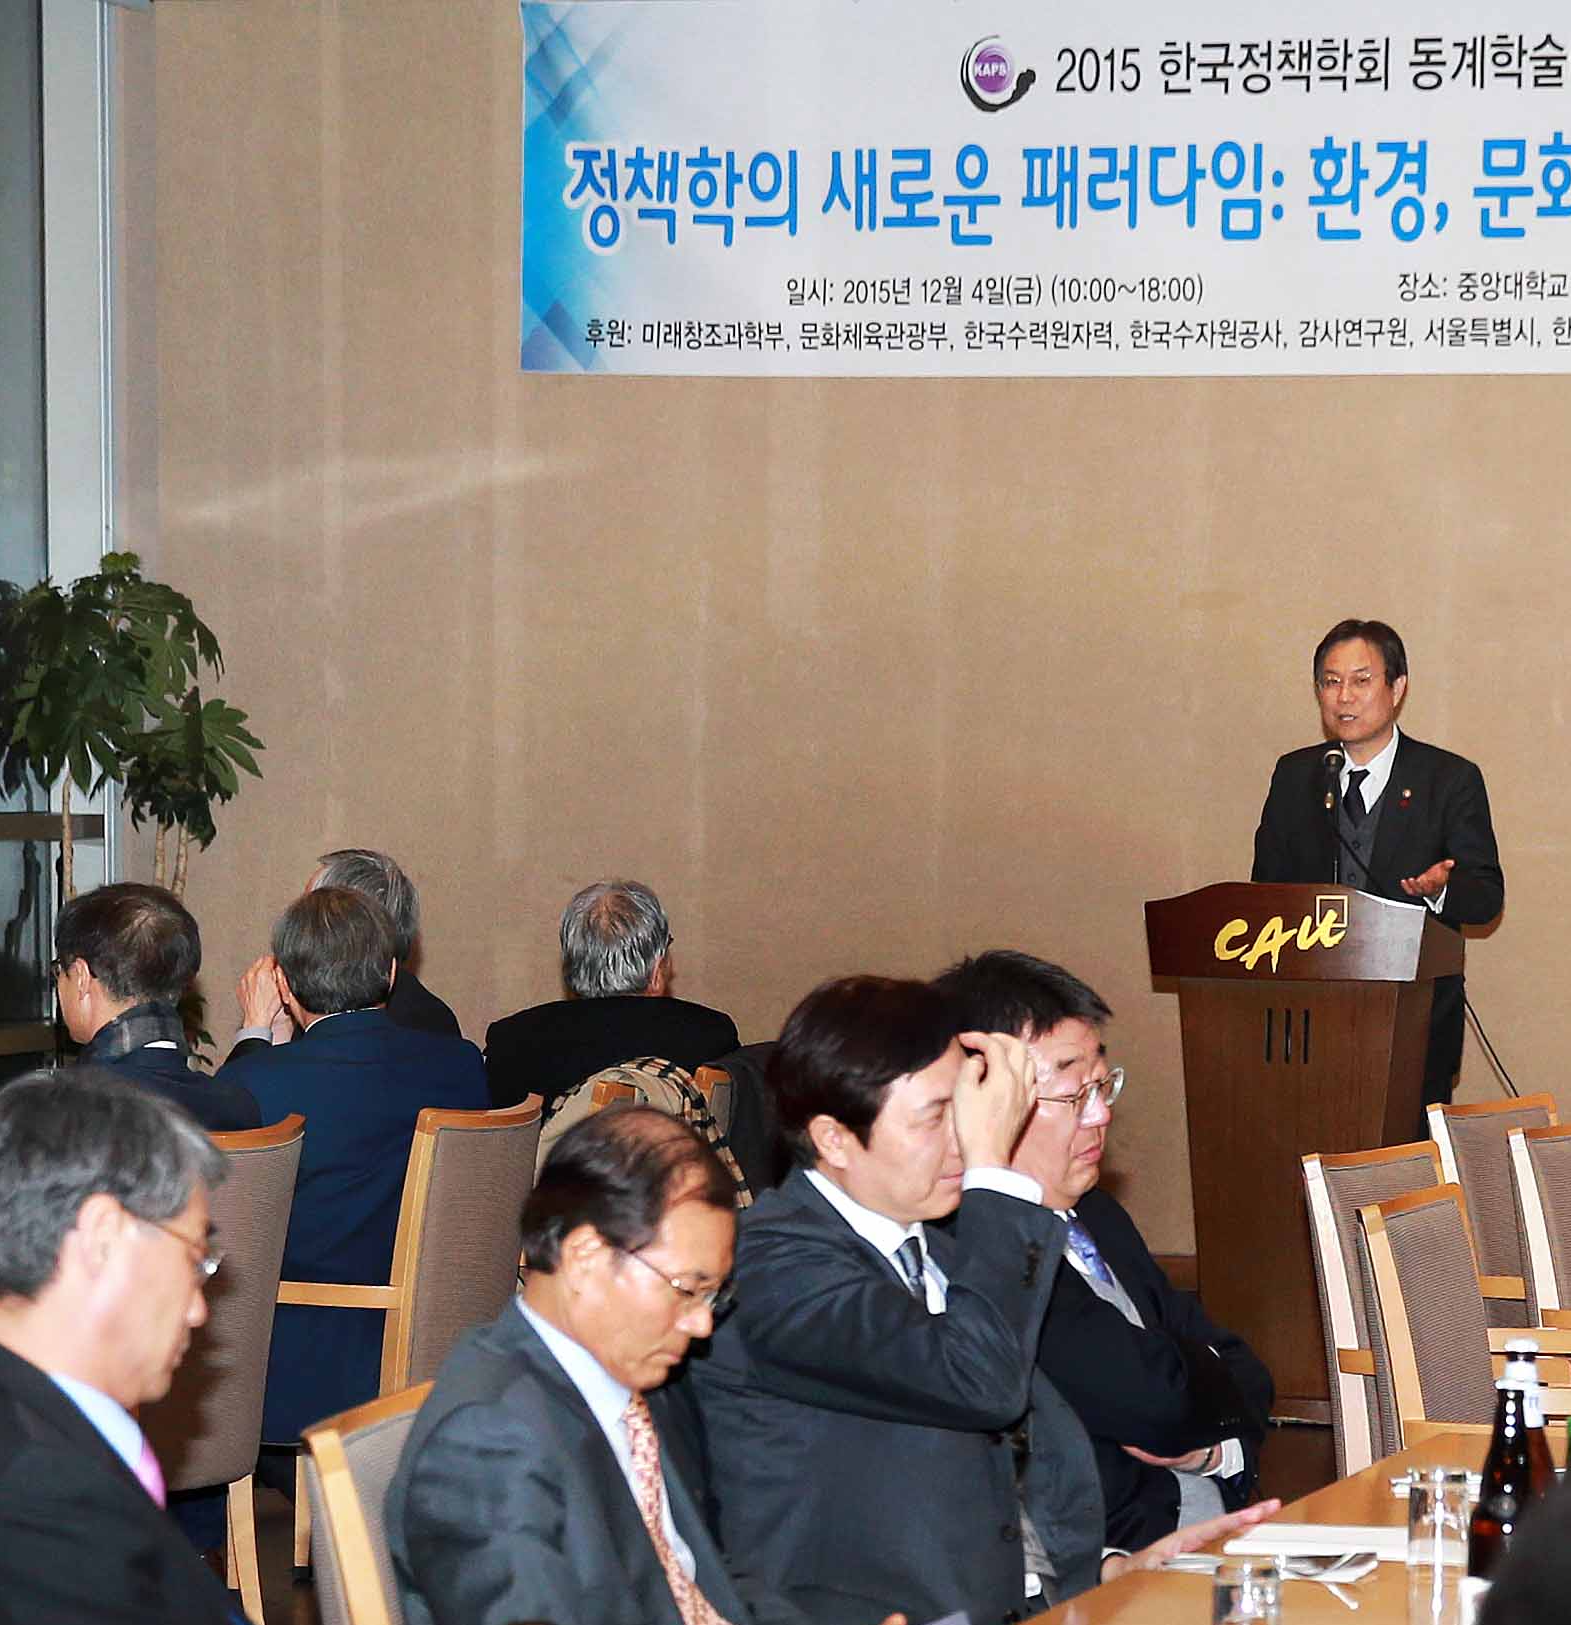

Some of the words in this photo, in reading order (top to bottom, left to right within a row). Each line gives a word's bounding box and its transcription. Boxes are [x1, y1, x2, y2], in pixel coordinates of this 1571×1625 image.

[1055, 47, 1141, 93] 2015
[1158, 36, 1390, 95] 한국정책학회
[570, 145, 799, 248] 정책학의
[821, 143, 1002, 246] 새로운
[1021, 140, 1286, 241] 패러다임:
[1308, 135, 1451, 242] 환경,
[787, 277, 834, 307] 일시:
[843, 277, 911, 305] 2015년
[921, 275, 962, 306] 12월
[971, 274, 1042, 307] 4일(금)
[1051, 273, 1204, 307] (10:00~18:00)
[1398, 271, 1448, 302] 장소:
[1458, 270, 1569, 302] 중앙대학교
[585, 320, 632, 350] 후원:
[642, 320, 791, 352] 미래창조과학부,
[799, 321, 954, 352] 문화체육관광부,
[964, 320, 1120, 352] 한국수력원자력,
[1130, 319, 1288, 350] 한국수자원공사,
[1299, 317, 1414, 349] 감사연구원,
[1424, 317, 1541, 348] 서울특별시,
[1213, 909, 1347, 973] CAU
